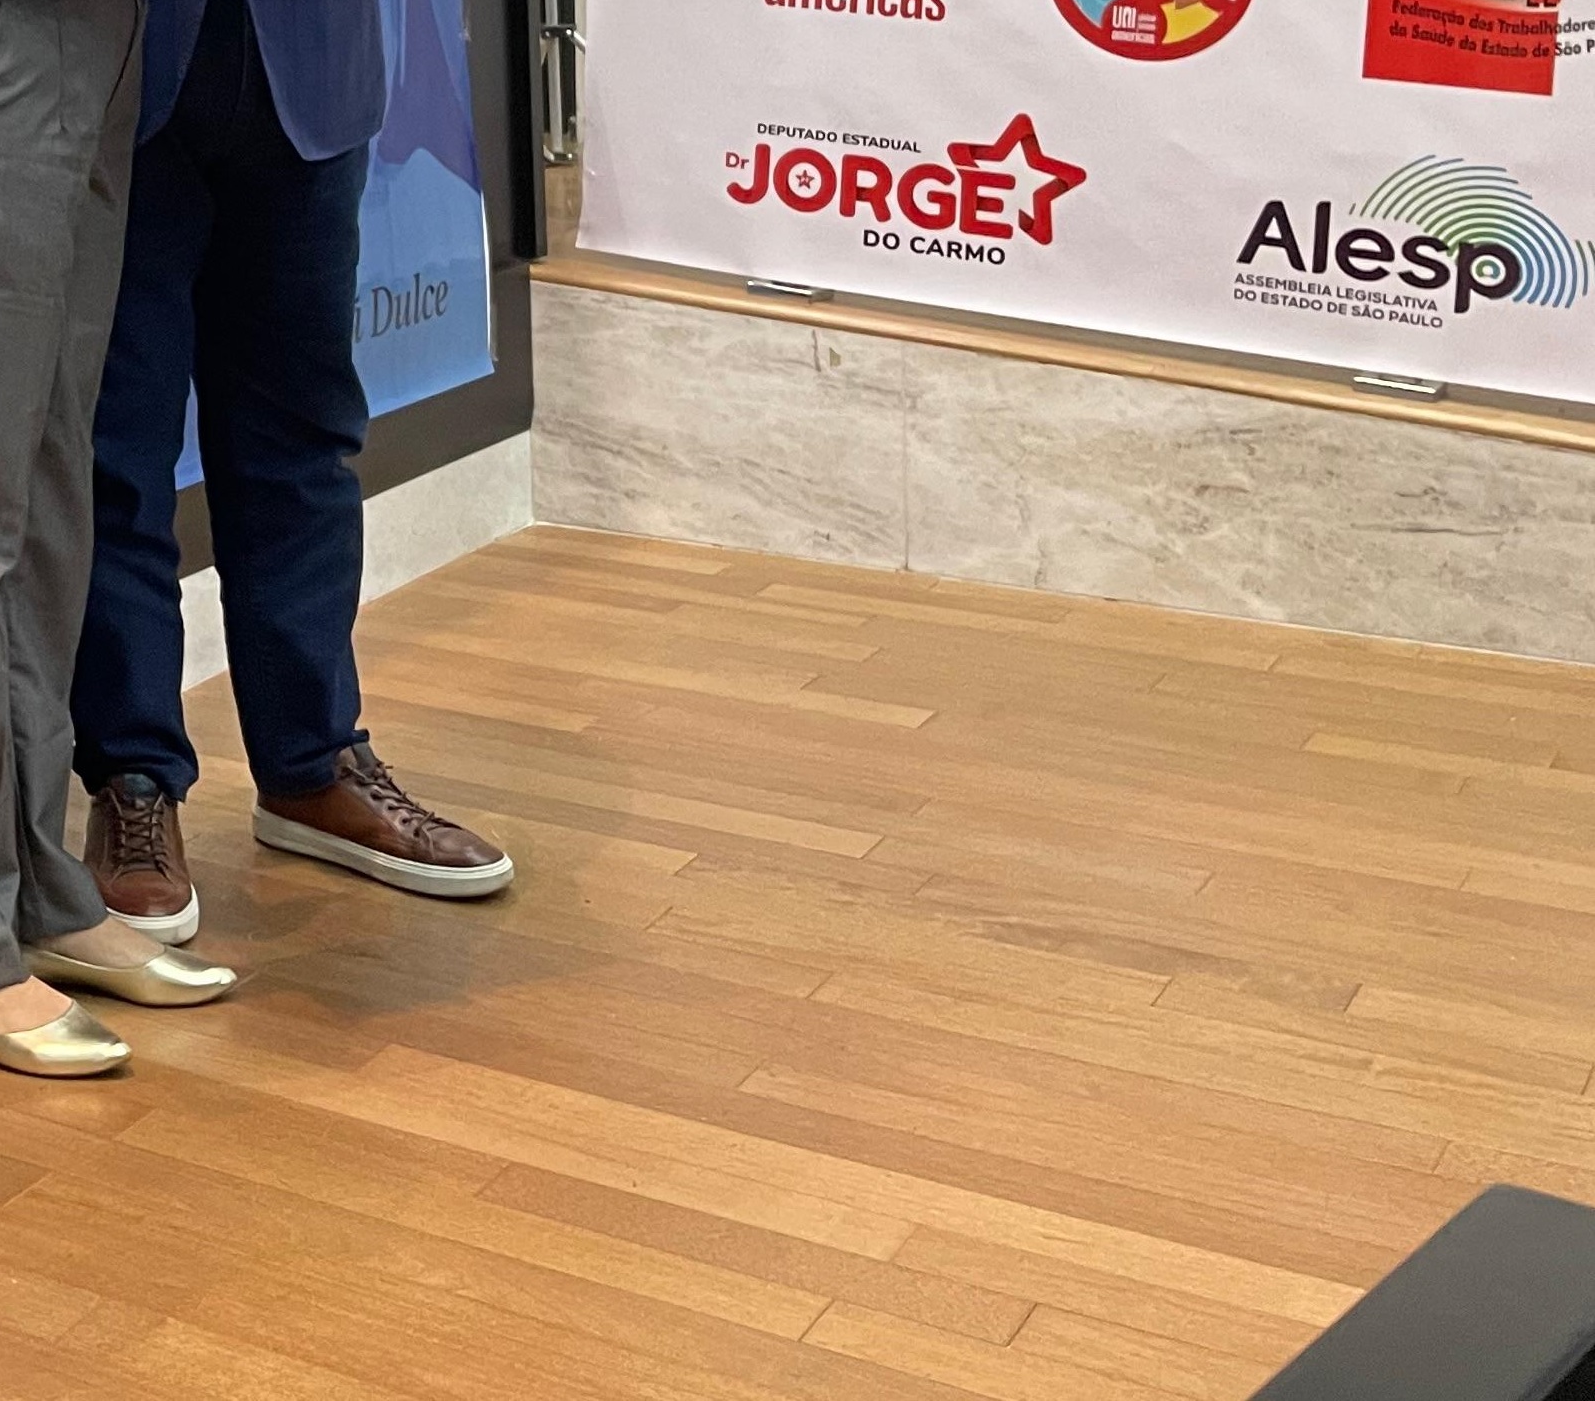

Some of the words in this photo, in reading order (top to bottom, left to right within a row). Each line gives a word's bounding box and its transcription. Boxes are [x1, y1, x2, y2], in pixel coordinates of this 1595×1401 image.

[1391, 0, 1465, 29] Federação
[1469, 14, 1493, 32] dos
[1411, 24, 1455, 47] Saúde
[1481, 39, 1528, 58] Estado
[1532, 41, 1550, 58] de
[1555, 40, 1582, 57] São
[757, 123, 838, 144] DEPUTADO
[842, 133, 921, 154] ESTADUAL
[725, 151, 749, 170] Dr
[727, 143, 1017, 240] JORGE
[863, 230, 900, 250] DO
[910, 237, 1006, 265] CARMO
[1236, 199, 1523, 315] Alesp
[371, 272, 449, 337] Dulce
[1233, 288, 1257, 303] DO
[1260, 292, 1323, 313] ESTADO
[1327, 301, 1348, 316] DE
[1351, 303, 1385, 321] SÃO
[1389, 309, 1443, 330] PAULO
[1234, 273, 1332, 298] ASSEMBLEIA
[1336, 286, 1439, 312] LEGISLATIVA
